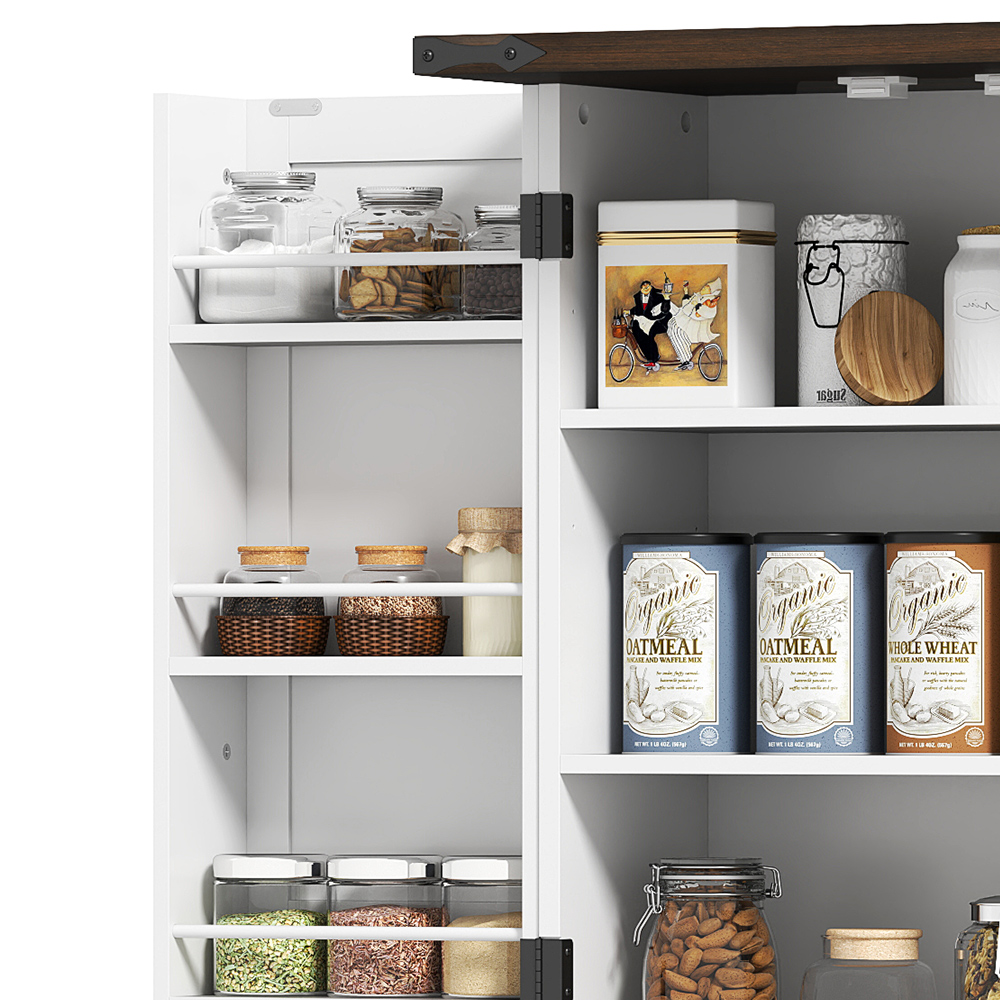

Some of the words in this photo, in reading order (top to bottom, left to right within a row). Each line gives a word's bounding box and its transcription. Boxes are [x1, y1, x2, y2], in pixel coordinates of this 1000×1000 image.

[625, 573, 701, 635] Organic
[759, 573, 836, 635] Organic
[889, 573, 967, 635] Organic
[626, 638, 703, 655] OATMEAL
[760, 638, 837, 655] OATMEAL
[888, 641, 921, 654] WHOLE
[925, 641, 978, 654] WHEAT
